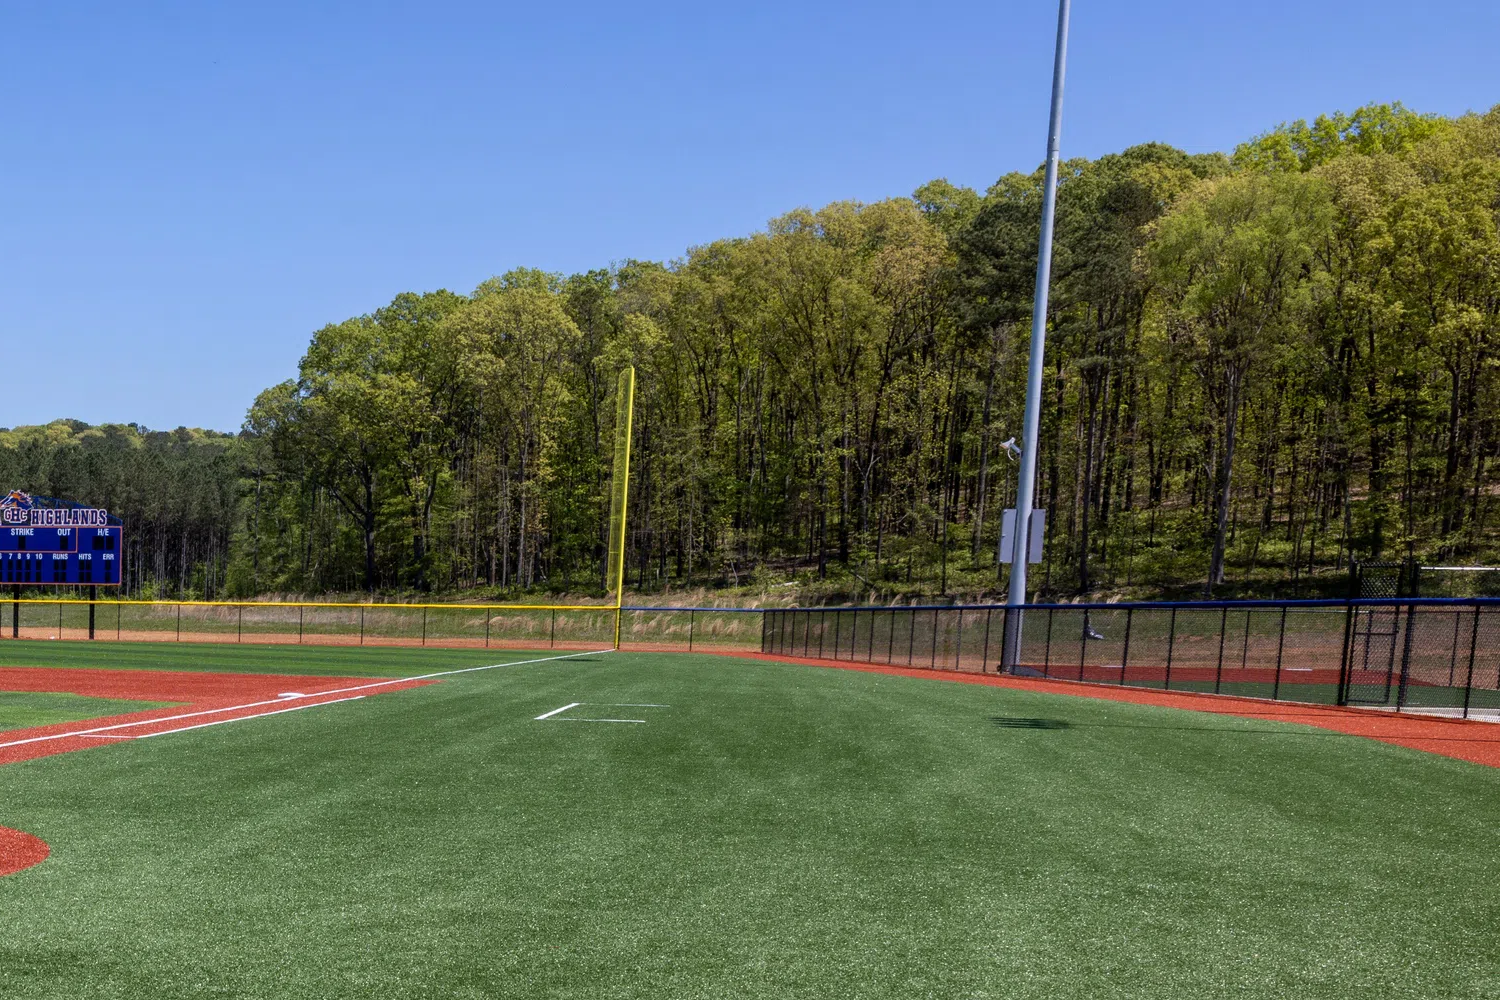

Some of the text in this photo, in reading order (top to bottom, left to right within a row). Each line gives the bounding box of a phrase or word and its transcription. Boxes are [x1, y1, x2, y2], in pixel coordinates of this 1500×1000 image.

[3, 507, 28, 523] GHC
[30, 508, 108, 526] HIGHLANDS
[10, 528, 34, 536] STRIKE
[57, 528, 71, 536] OUT
[97, 528, 109, 536] H/E
